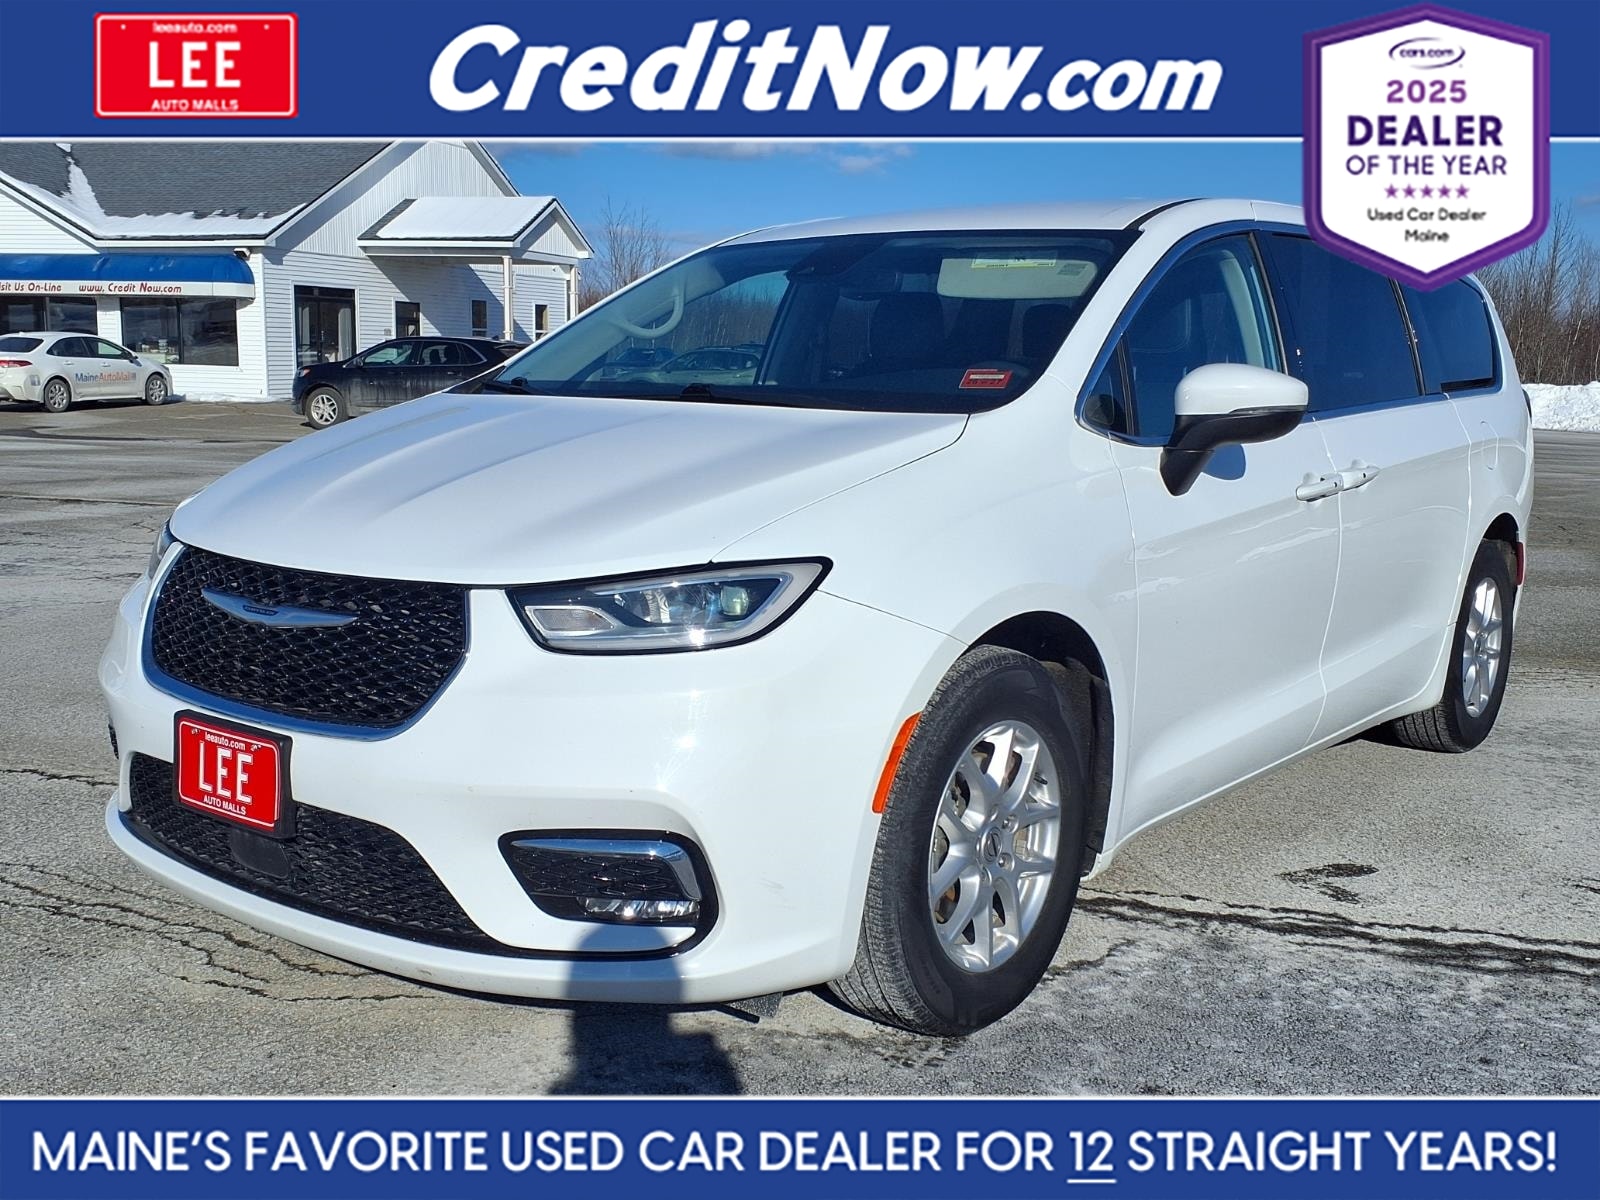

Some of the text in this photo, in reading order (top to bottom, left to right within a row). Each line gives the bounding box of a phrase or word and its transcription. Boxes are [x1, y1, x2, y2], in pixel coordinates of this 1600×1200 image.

[15, 282, 24, 291] Us
[28, 282, 62, 292] On-Line
[108, 282, 136, 293] Credit
[139, 282, 182, 293] Now.com
[205, 731, 246, 751] leeauto.com
[198, 740, 254, 805] LEE
[203, 795, 247, 815] AUTO MALLS
